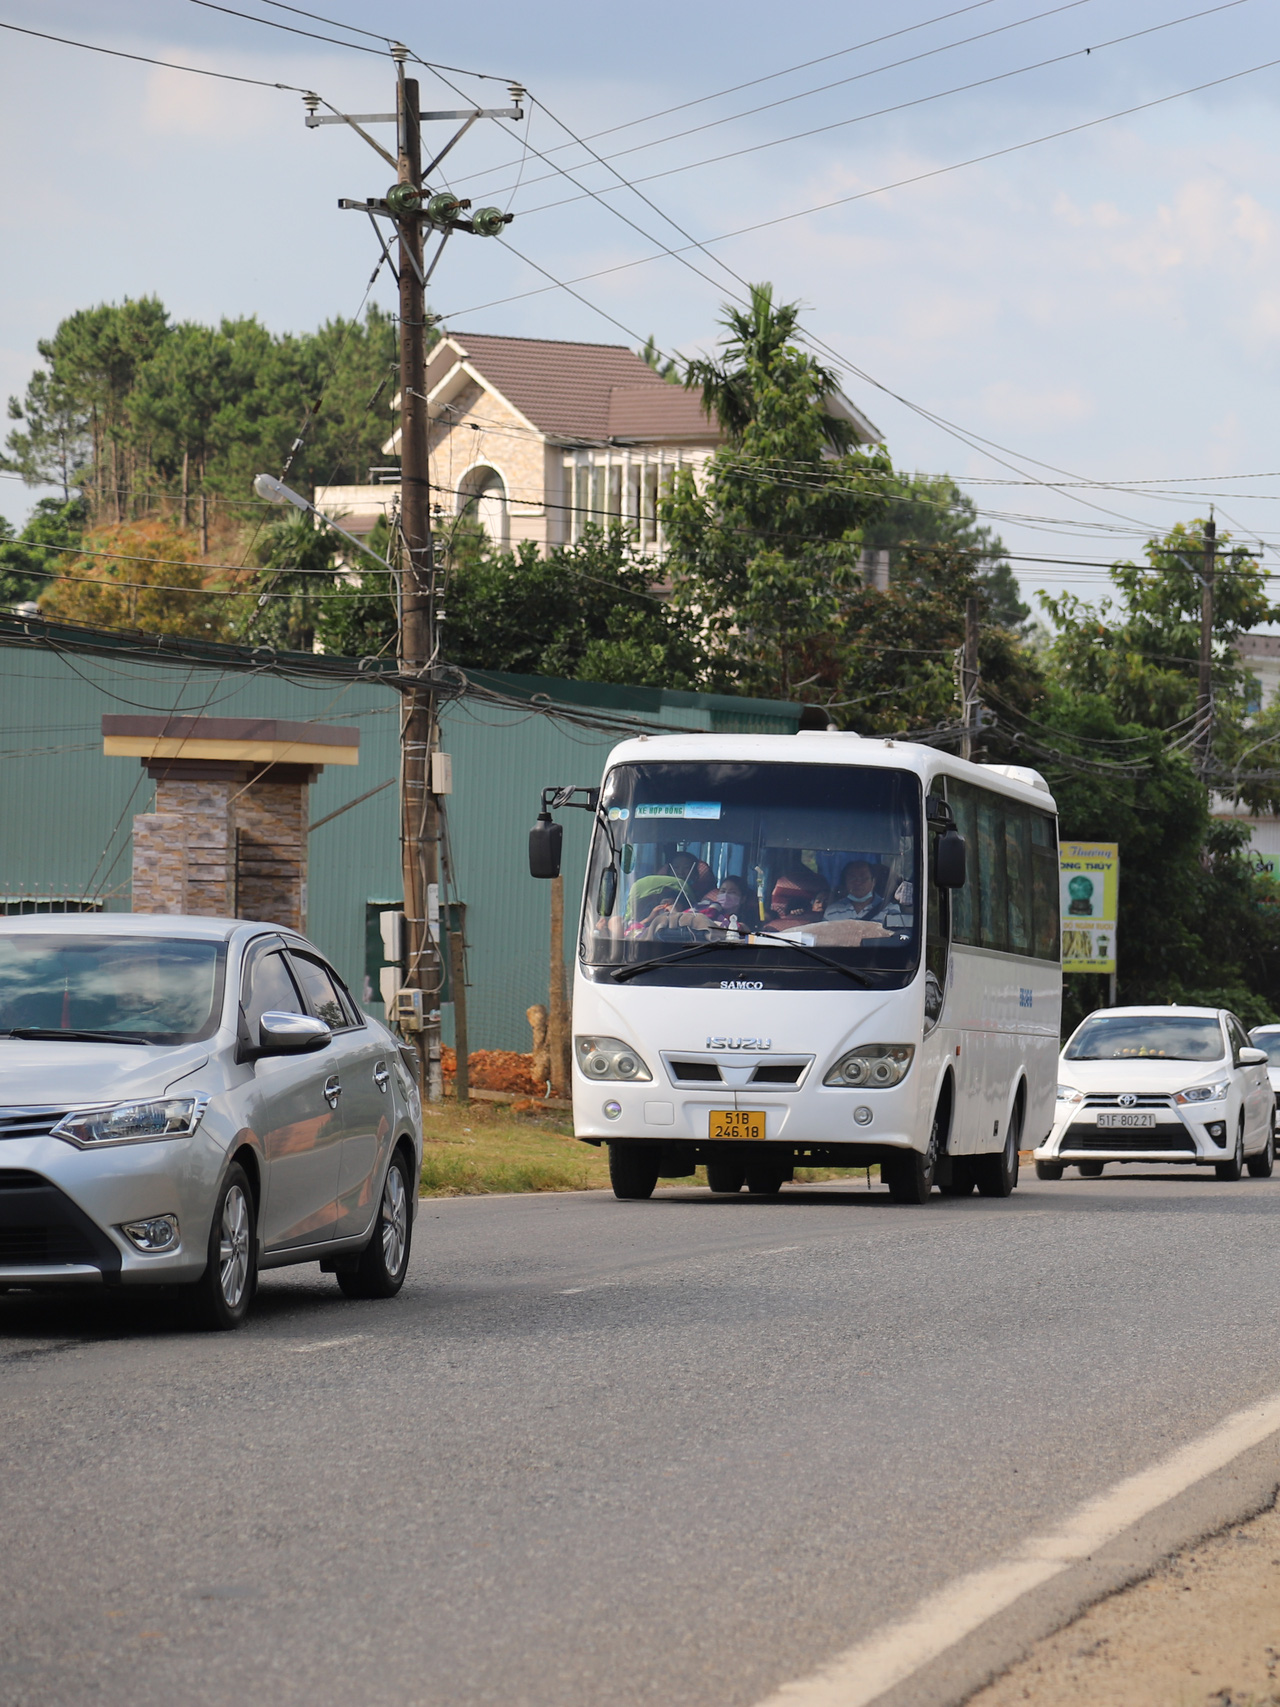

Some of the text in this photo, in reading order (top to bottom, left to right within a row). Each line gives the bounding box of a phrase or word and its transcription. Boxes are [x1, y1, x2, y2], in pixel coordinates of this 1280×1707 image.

[720, 981, 763, 990] SAMCO
[706, 1037, 771, 1050] ISUZU
[725, 1113, 749, 1124] 51B
[715, 1126, 759, 1137] 246.18
